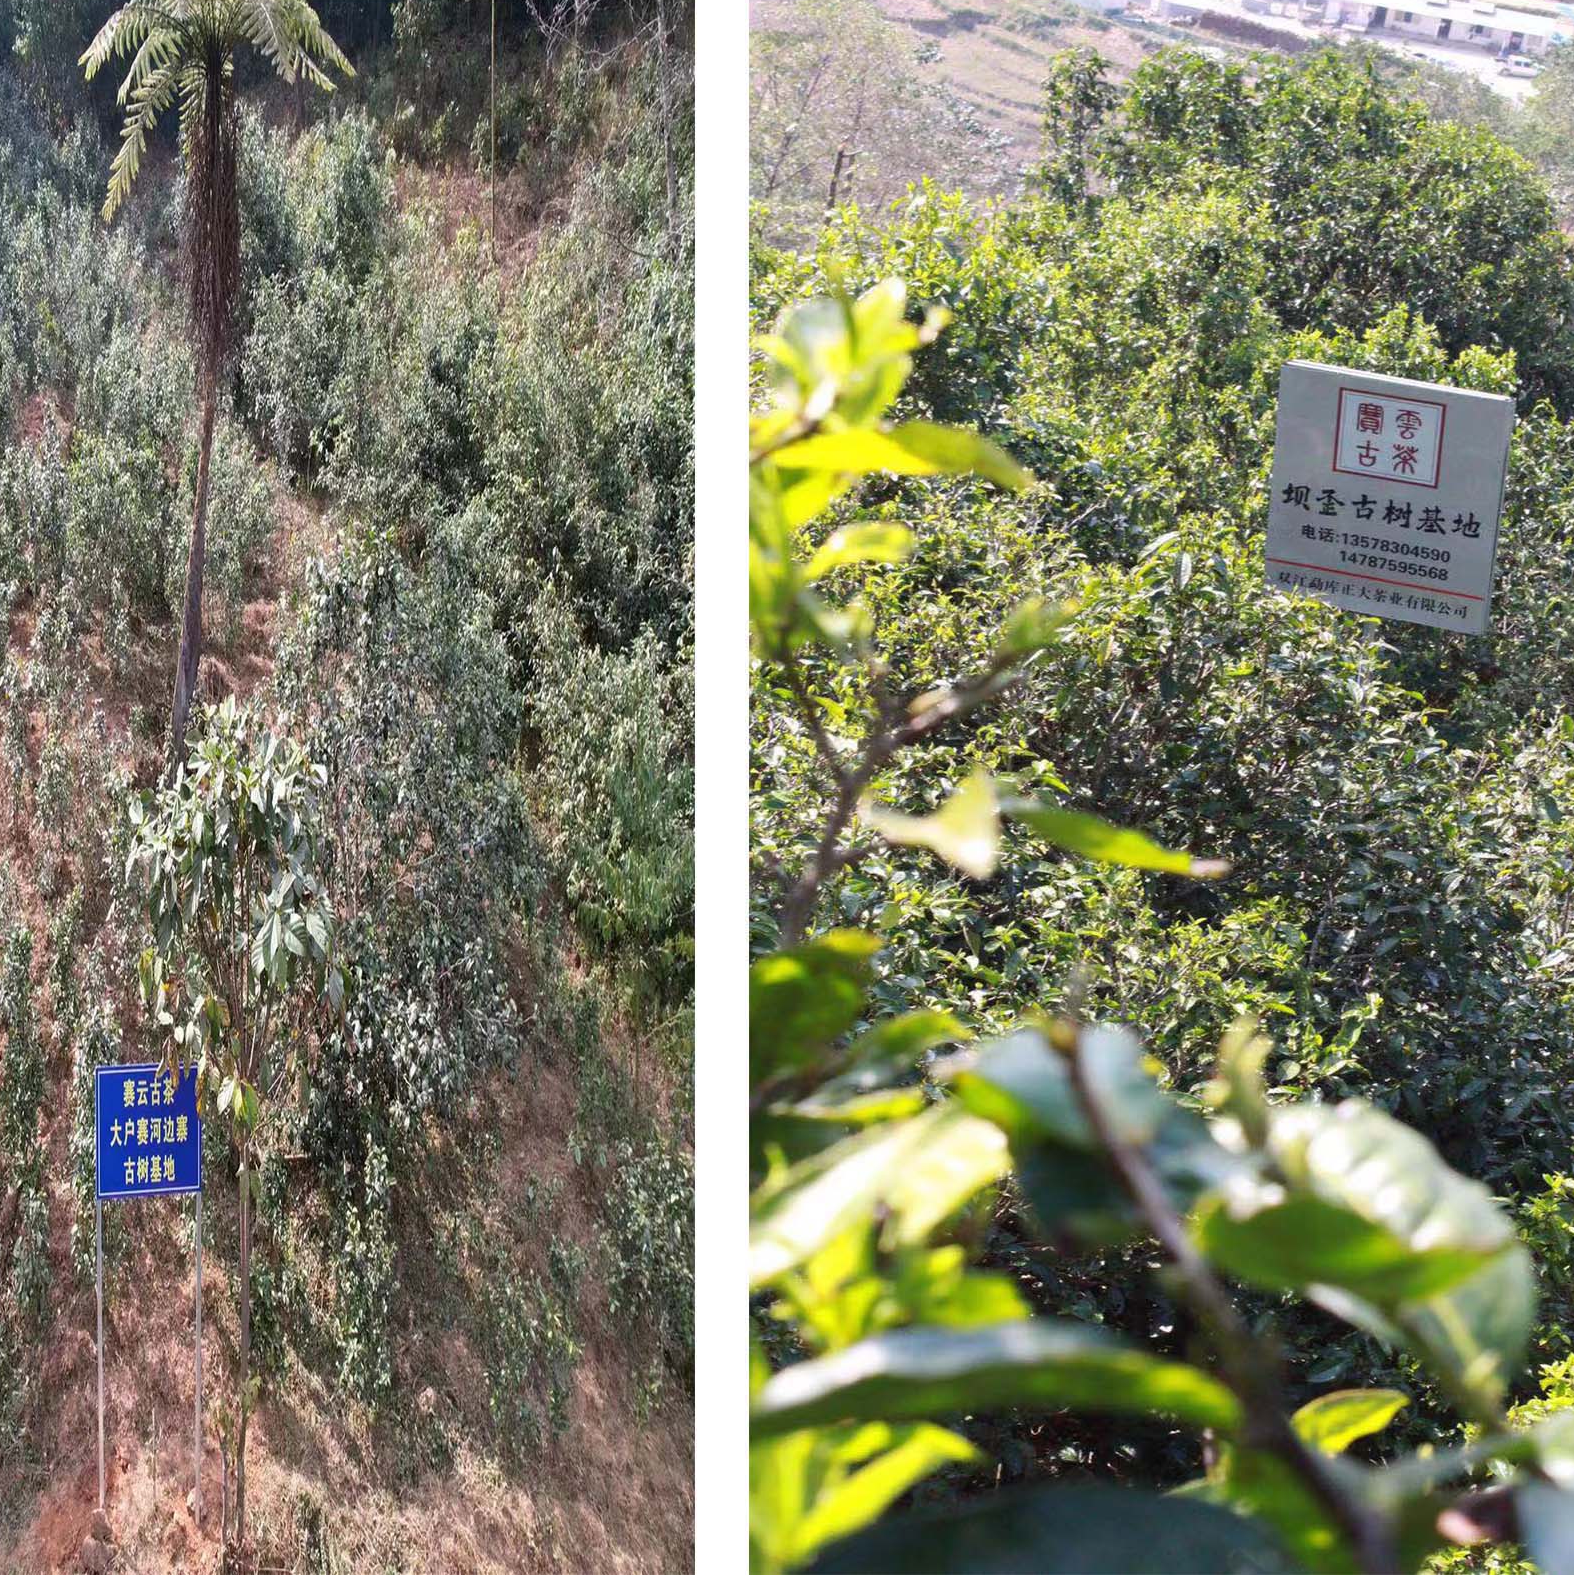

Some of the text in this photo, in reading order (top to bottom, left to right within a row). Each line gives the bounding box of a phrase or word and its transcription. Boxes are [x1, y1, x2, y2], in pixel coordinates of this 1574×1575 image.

[1282, 483, 1481, 539] 坝歪古树基地
[1340, 550, 1449, 582] 14787595568
[1278, 571, 1468, 619] 双江勐库正大茶业有限公司
[123, 1077, 175, 1108] 赛云古茶
[110, 1114, 188, 1147] 大户赛河边寨
[123, 1154, 176, 1186] 古树基地
